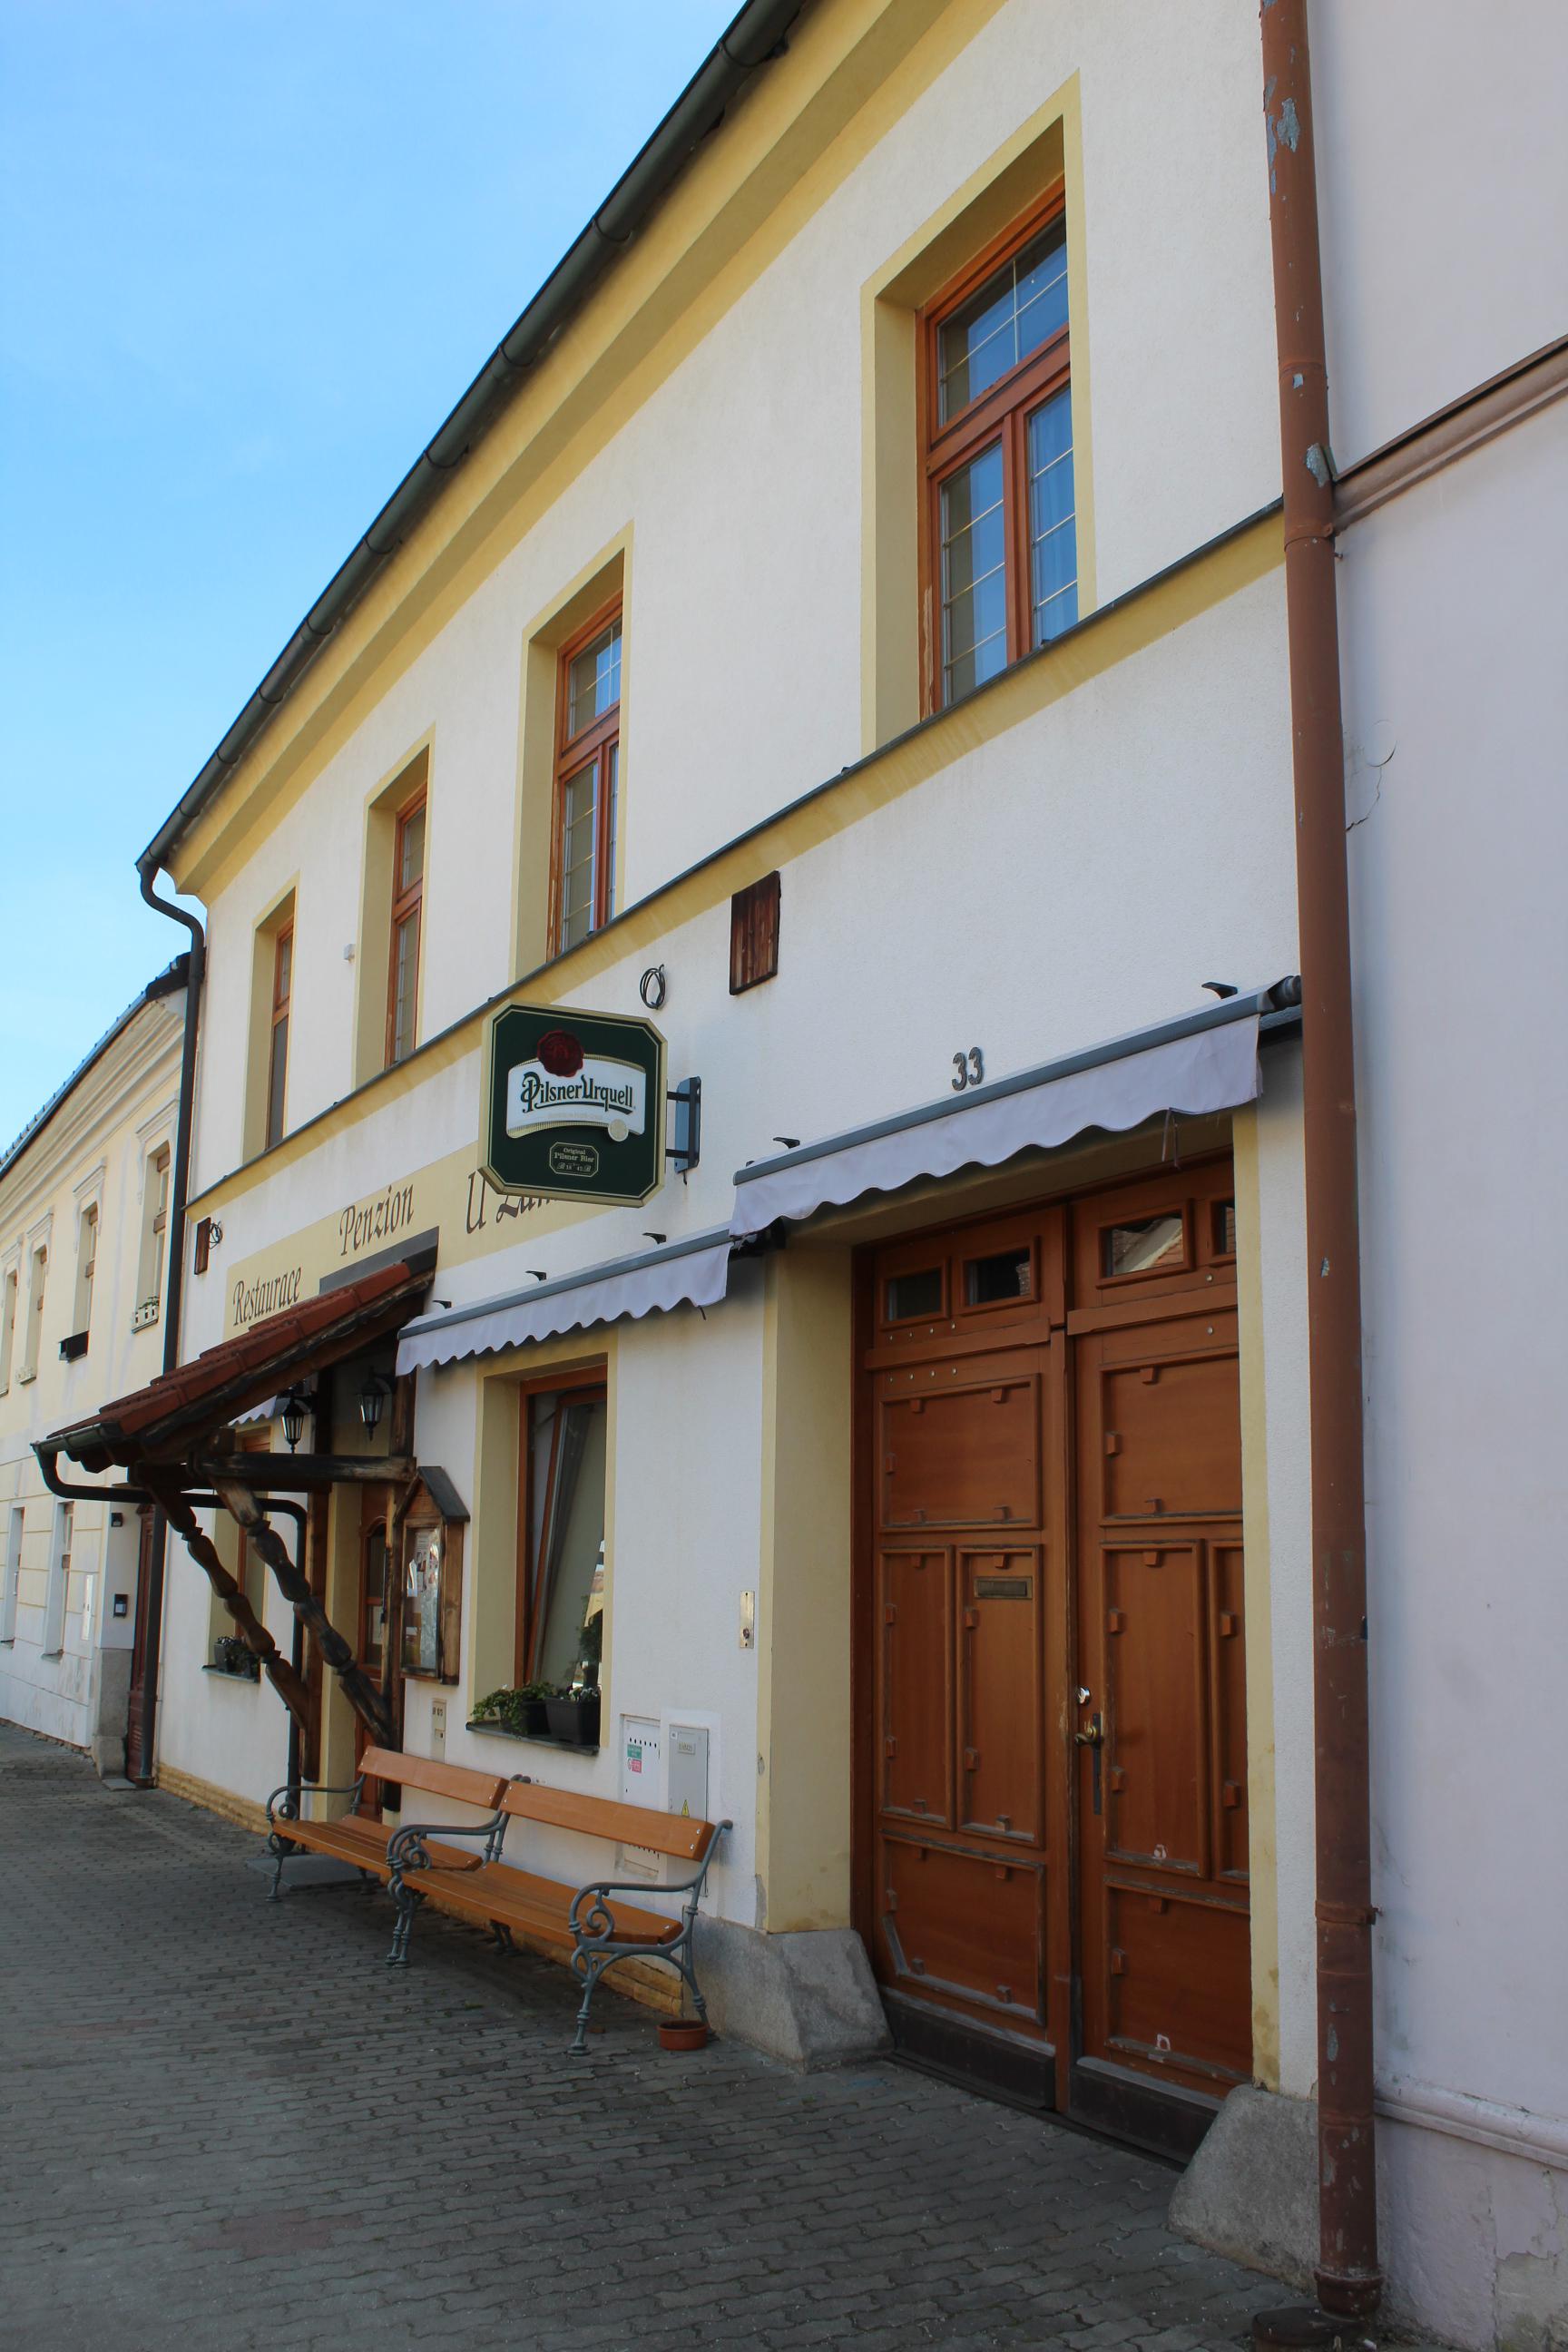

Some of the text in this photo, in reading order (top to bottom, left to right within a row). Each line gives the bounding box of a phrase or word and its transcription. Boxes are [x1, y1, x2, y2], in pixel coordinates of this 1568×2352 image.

[951, 1046, 983, 1092] 33
[520, 1071, 633, 1113] Pilsner Urquell
[563, 1147, 586, 1155] Original
[232, 1266, 301, 1327] Restaurace
[339, 1183, 415, 1256] Penzion
[466, 1171, 486, 1235] U
